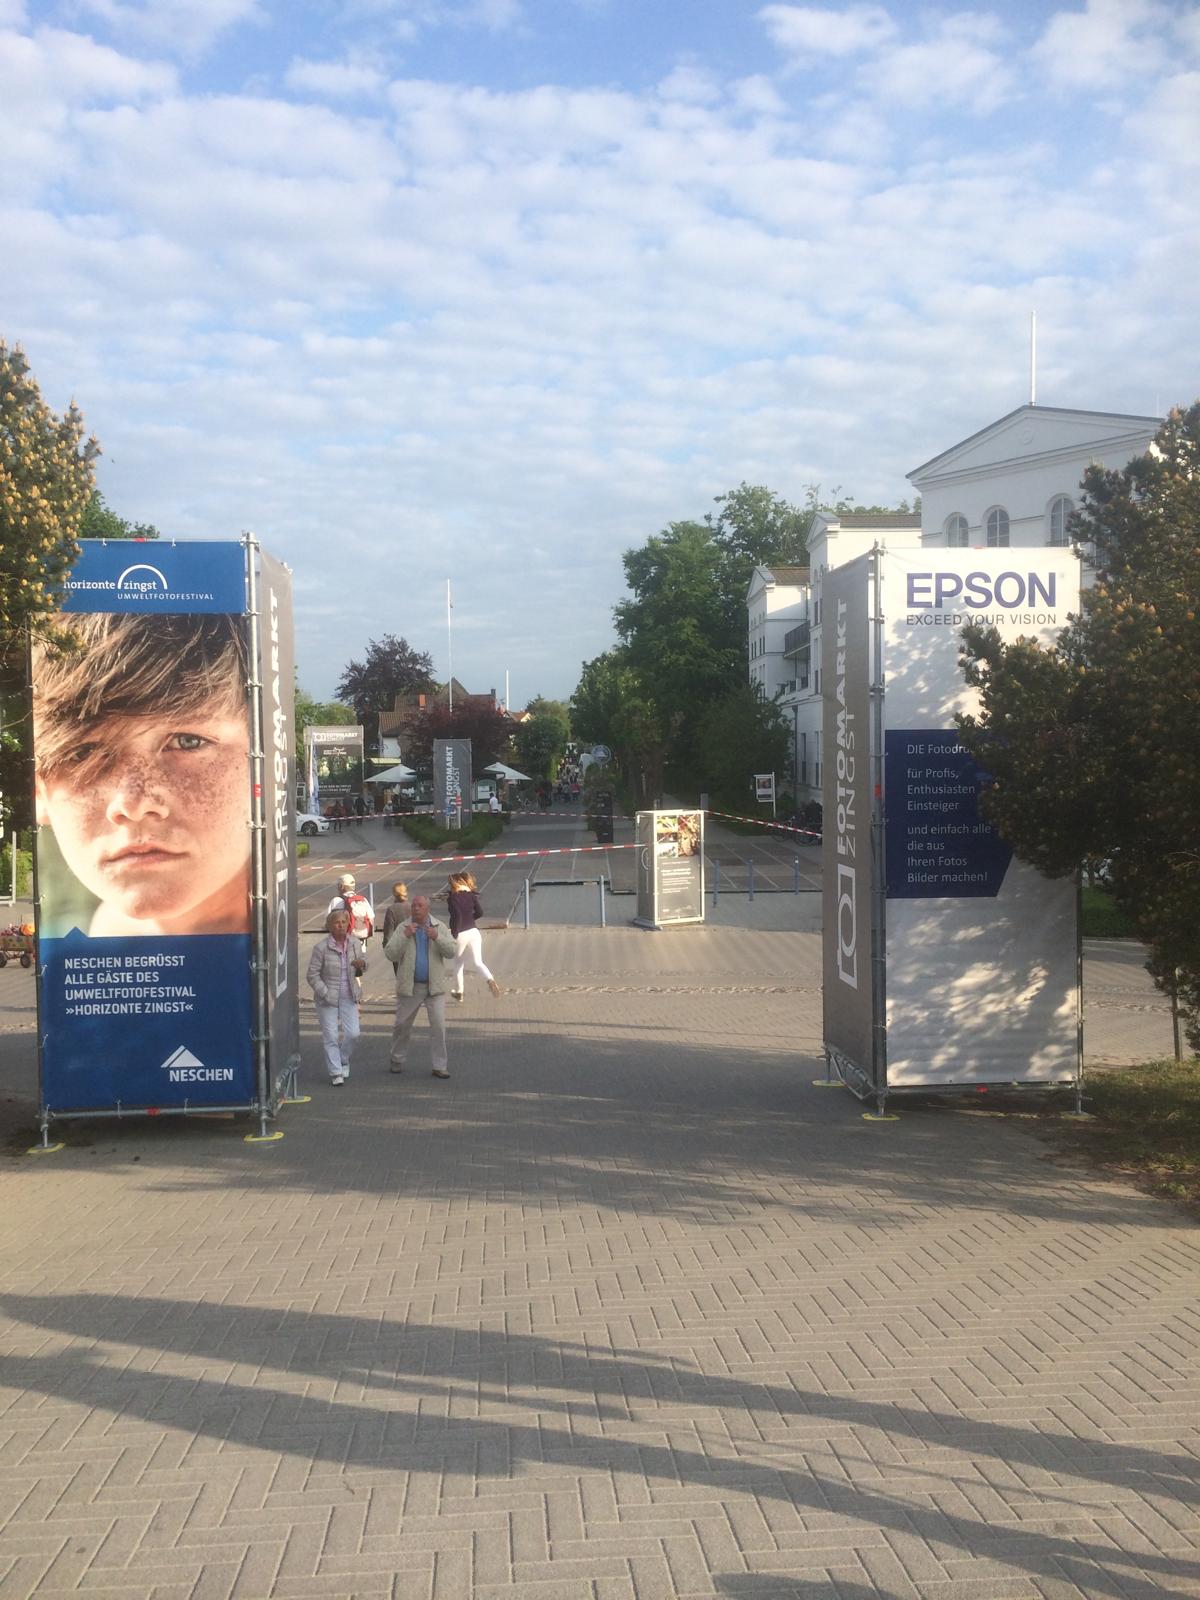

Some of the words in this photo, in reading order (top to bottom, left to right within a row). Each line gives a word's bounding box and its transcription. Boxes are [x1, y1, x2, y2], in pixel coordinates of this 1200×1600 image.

[64, 580, 116, 590] horizonte
[123, 579, 157, 593] zingst
[906, 571, 1056, 609] EPSON
[906, 614, 962, 626] EXCEED
[967, 614, 1005, 625] YOUR
[1009, 613, 1057, 625] VISION
[270, 587, 283, 863] FOTOMARKT
[836, 598, 847, 855] FOTOMARKT
[907, 744, 925, 755] DIE
[928, 744, 973, 754] Fotodru
[907, 768, 922, 779] für
[925, 769, 960, 780] Profis,
[280, 713, 288, 857] ZINGST
[846, 706, 856, 858] ZINGST
[907, 784, 976, 795] Enthusiasten
[907, 800, 960, 813] Einsteiger
[907, 824, 928, 835] und
[930, 823, 970, 834] einfach
[972, 823, 992, 834] alle
[907, 840, 924, 851] die
[926, 842, 945, 851] aus
[907, 857, 935, 867] Ihren
[938, 856, 968, 867] Fotos
[907, 872, 939, 883] Bilder
[941, 871, 988, 882] machen!
[64, 957, 122, 969] NESCHEN
[124, 954, 185, 967] BEGRÜSST
[64, 974, 94, 985] ALLE
[96, 970, 134, 984] GÄSTE
[136, 971, 160, 983] DES
[65, 986, 196, 1000] UMWELTFOTOFESTIVAL
[169, 1068, 234, 1082] NESCHEN
